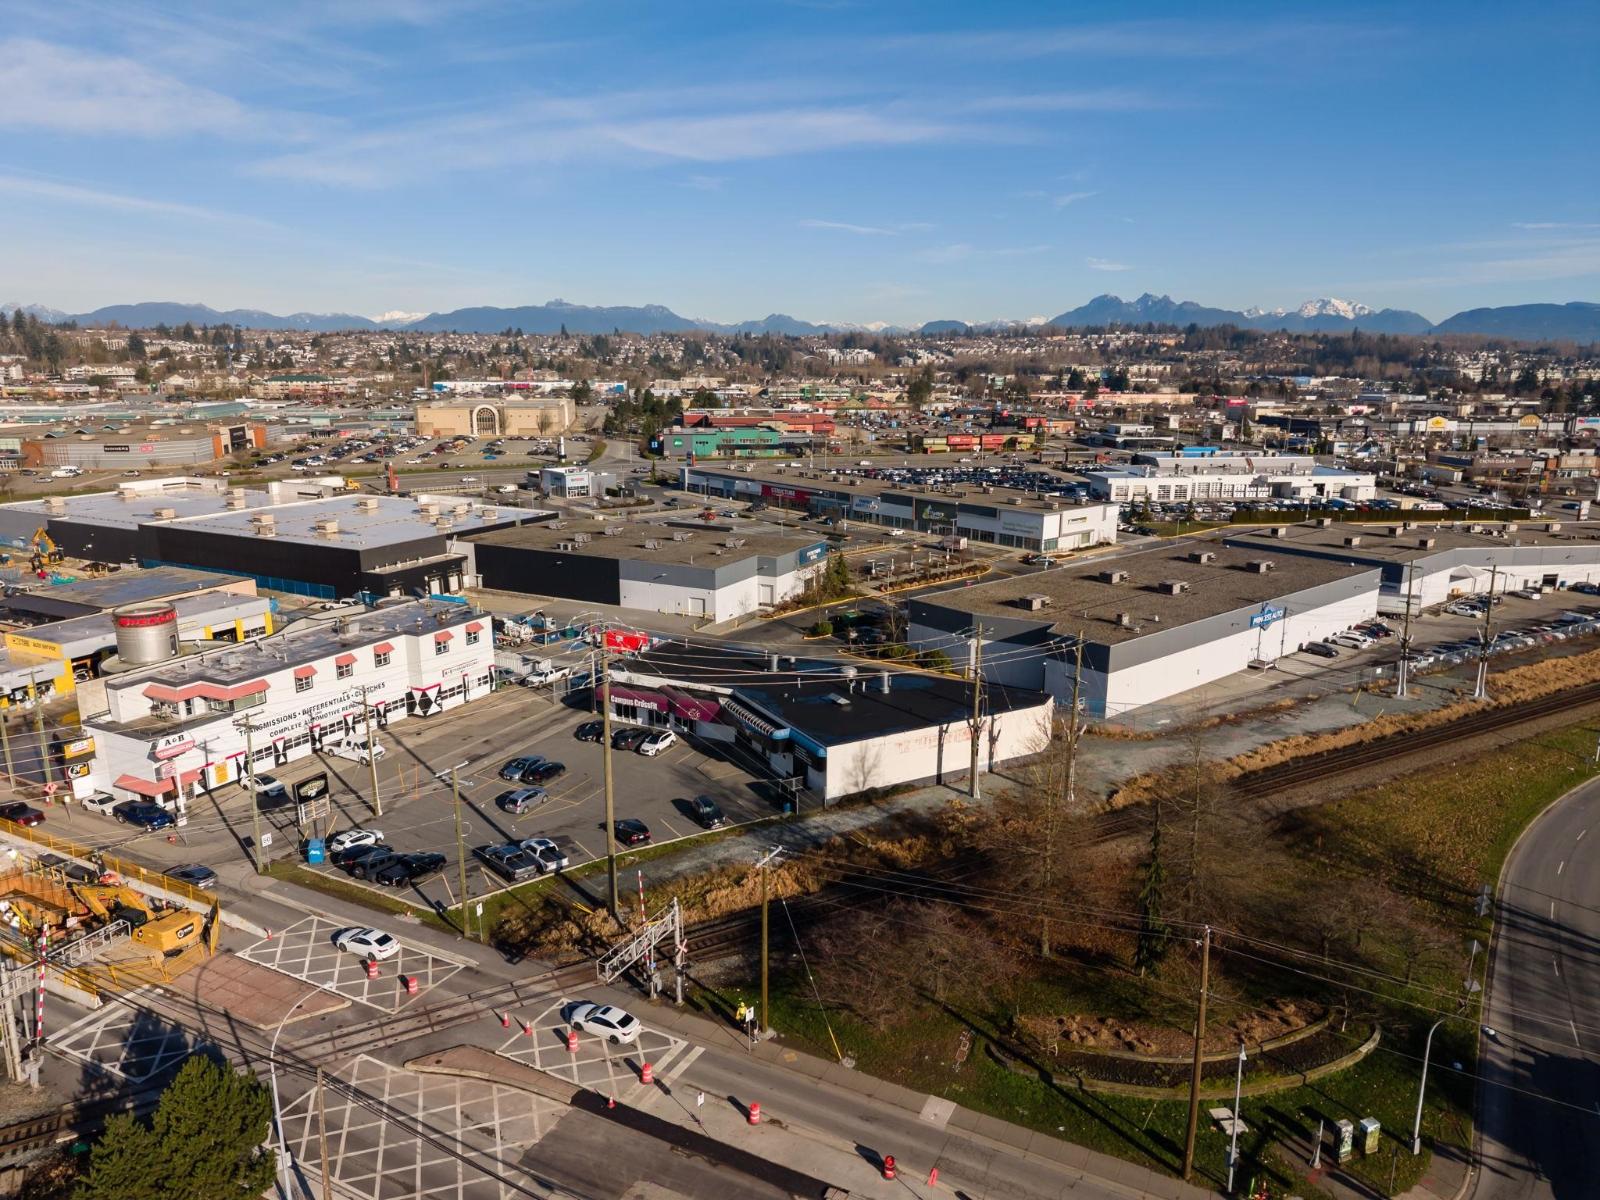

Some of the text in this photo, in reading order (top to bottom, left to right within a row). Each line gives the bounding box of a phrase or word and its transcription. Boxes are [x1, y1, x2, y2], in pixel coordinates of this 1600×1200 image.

[302, 694, 351, 715] DIFFERENTIALS
[355, 681, 386, 697] CLTCHES
[611, 695, 634, 706] Campus
[270, 722, 302, 738] COMPLETE
[178, 734, 185, 742] B
